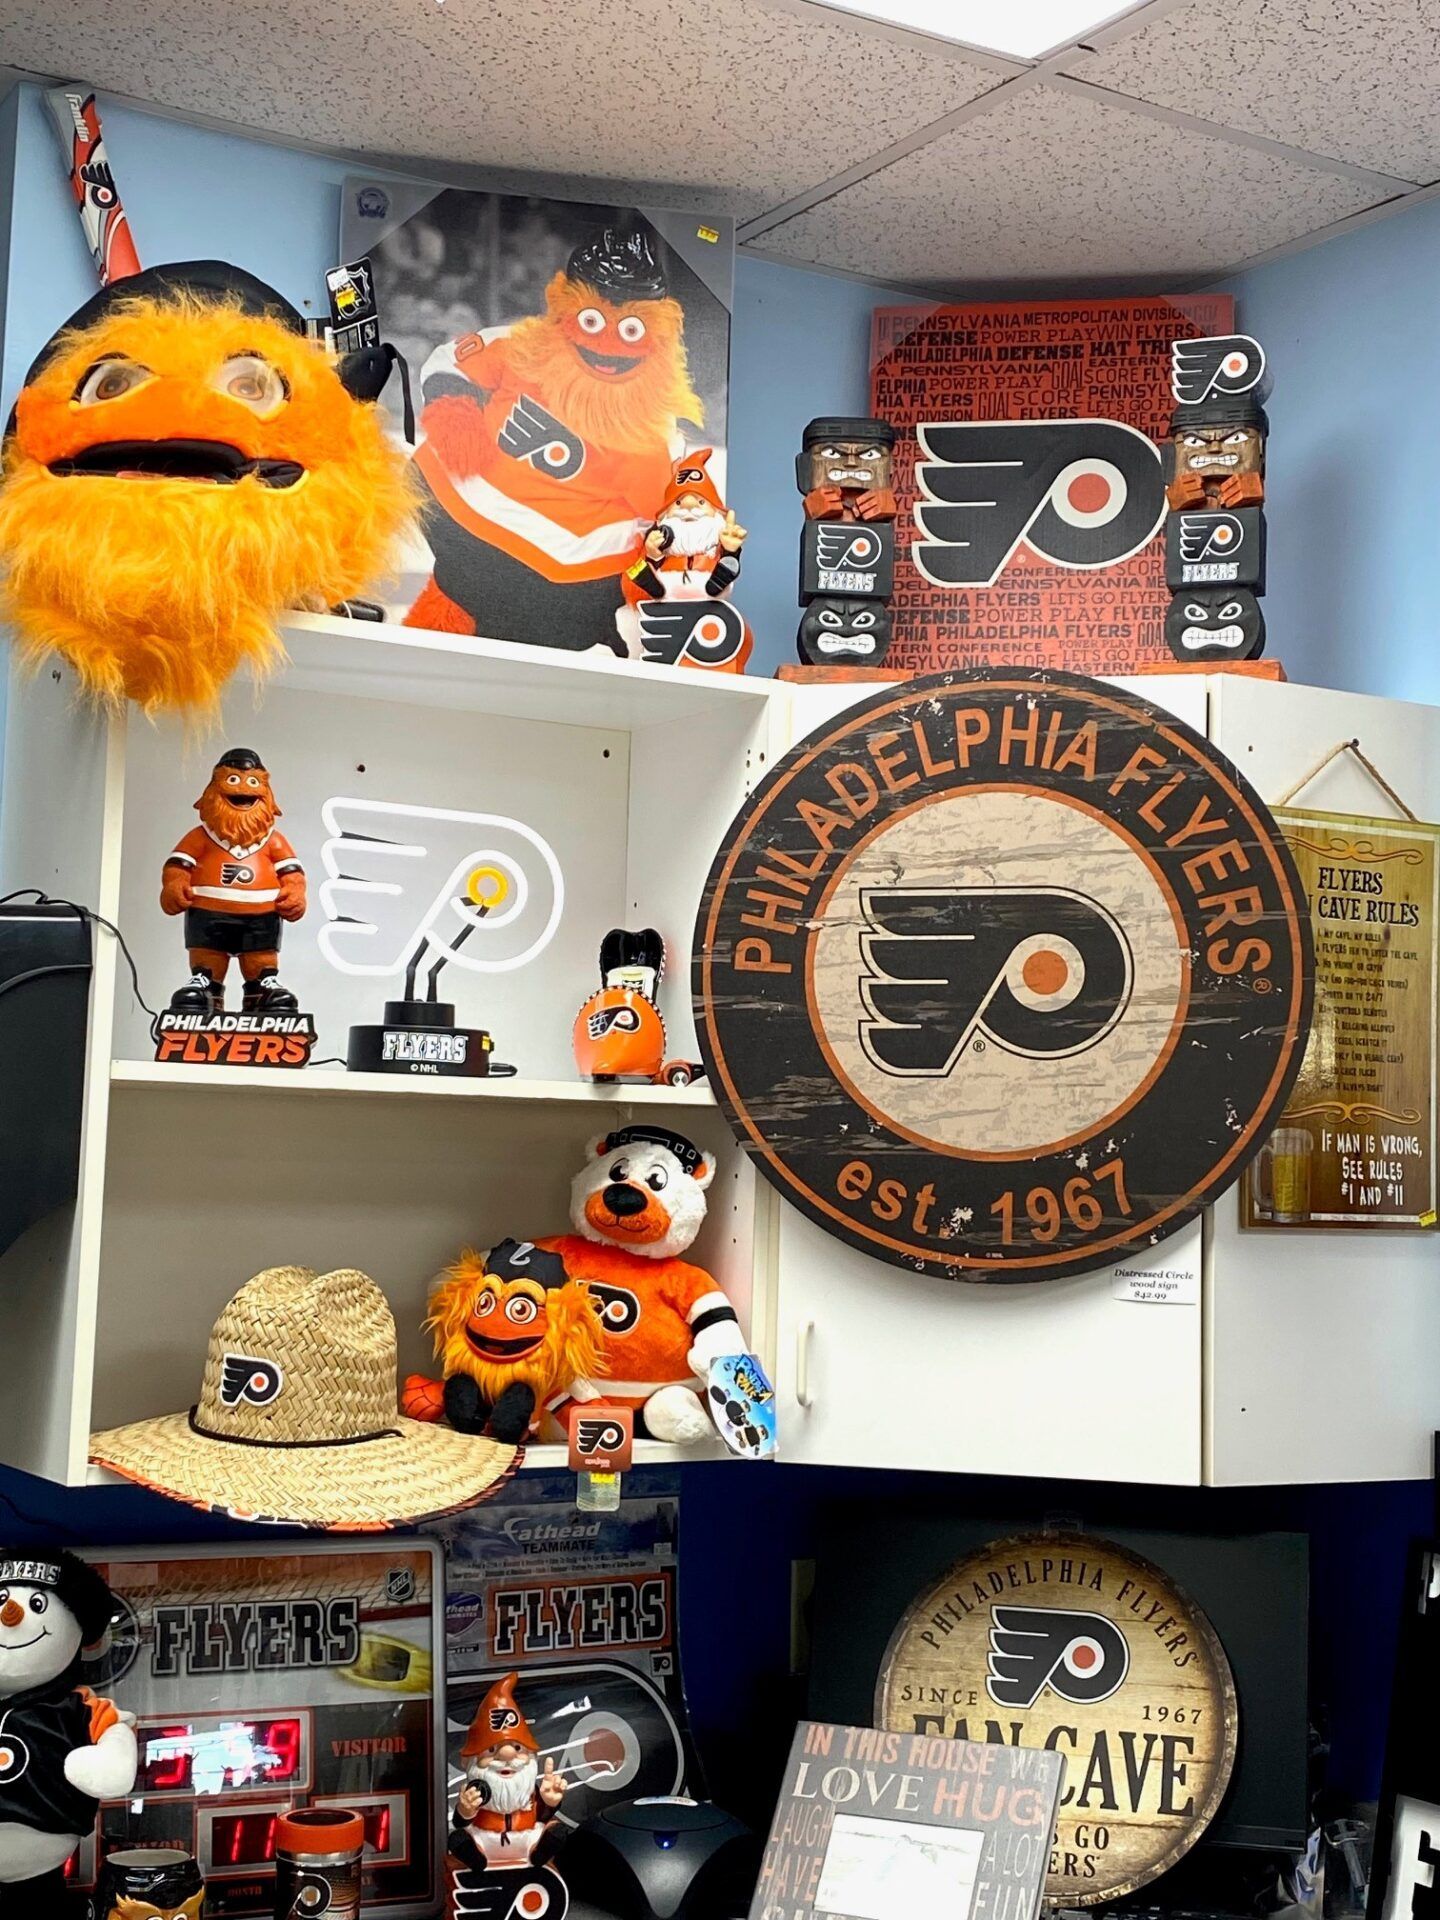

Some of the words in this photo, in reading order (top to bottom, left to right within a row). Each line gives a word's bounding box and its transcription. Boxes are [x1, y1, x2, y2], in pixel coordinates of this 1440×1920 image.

[892, 312, 1021, 331] PENNSYLVANIA
[1023, 308, 1129, 325] METROPOLITAN
[980, 329, 1041, 344] POWER
[1046, 328, 1095, 342] PLAY
[1095, 324, 1133, 340] WIN
[1136, 322, 1195, 339] FLYERS
[894, 346, 993, 364] PHILADELPHIA
[996, 344, 1084, 361] DEFENSE
[1089, 340, 1131, 357] HAT
[1137, 339, 1173, 355] TRI
[900, 363, 1052, 377] PENNSYLVANIA
[1088, 357, 1160, 368] EASTERN
[929, 376, 989, 391] POWER
[994, 375, 1044, 390] PLAY
[1084, 367, 1139, 384] SCORE
[1143, 366, 1171, 381] FLY
[910, 393, 973, 408] FLYERS
[977, 391, 1014, 420] GOAL
[1012, 389, 1084, 406] SCORE
[1088, 383, 1173, 400] PENNSYLV
[1129, 399, 1153, 411] GO
[916, 408, 973, 422] DIVISION
[1020, 406, 1079, 421] FLYERS
[1116, 560, 1161, 576] SCOR
[1181, 562, 1239, 582] FLYERS
[817, 570, 876, 591] FLYERS
[975, 591, 1041, 607] FLYERS
[1091, 591, 1116, 604] GO
[973, 608, 1043, 623] POWER
[1050, 607, 1105, 622] PLAY
[936, 624, 1060, 640] PHILADELPHIA
[1065, 623, 1131, 638] FLYERS
[936, 641, 1043, 654] CONFERENCE
[1105, 649, 1130, 661] GO
[1135, 648, 1171, 661] FLYE
[734, 704, 1099, 975] PHILADELPHIA
[1108, 743, 1272, 976] FLYERS
[1317, 866, 1384, 896] FLYERS
[1318, 895, 1362, 921] CAVE
[1365, 900, 1420, 927] RULES
[160, 1014, 309, 1034] PHILADELPHIA
[157, 1033, 306, 1063] FLYERS
[382, 1032, 468, 1063] FLYERS
[1337, 1133, 1360, 1154] MAN
[1369, 1160, 1403, 1180] RULES
[990, 1157, 1134, 1246] 1967
[1360, 1187, 1381, 1206] AND
[1114, 1268, 1163, 1279] Distressed
[1165, 1271, 1194, 1280] Circle
[1130, 1281, 1156, 1289] wood
[1157, 1281, 1179, 1290] sign
[521, 1539, 596, 1555] TEAMMATE
[0, 1560, 61, 1584] LYERS
[493, 1579, 666, 1655] FLYERS
[920, 1558, 1104, 1650] PHILADELPHIA
[1116, 1579, 1198, 1669] FLYERS
[152, 1597, 360, 1676] FLYERS
[901, 1685, 978, 1706] SINCE
[1142, 1705, 1203, 1725] 1967
[331, 1737, 407, 1757] VISITOR
[803, 1724, 834, 1756] IN
[843, 1726, 900, 1764] THIS
[908, 1734, 998, 1776] HOUSE
[792, 1762, 924, 1812] LOVE
[932, 1778, 1044, 1827] HUG
[771, 1801, 834, 1848] LAUGH
[1075, 1825, 1110, 1850] GO
[1047, 1853, 1096, 1879] ERS
[760, 1851, 823, 1902] HAVE
[972, 1882, 1035, 1920] FUN
